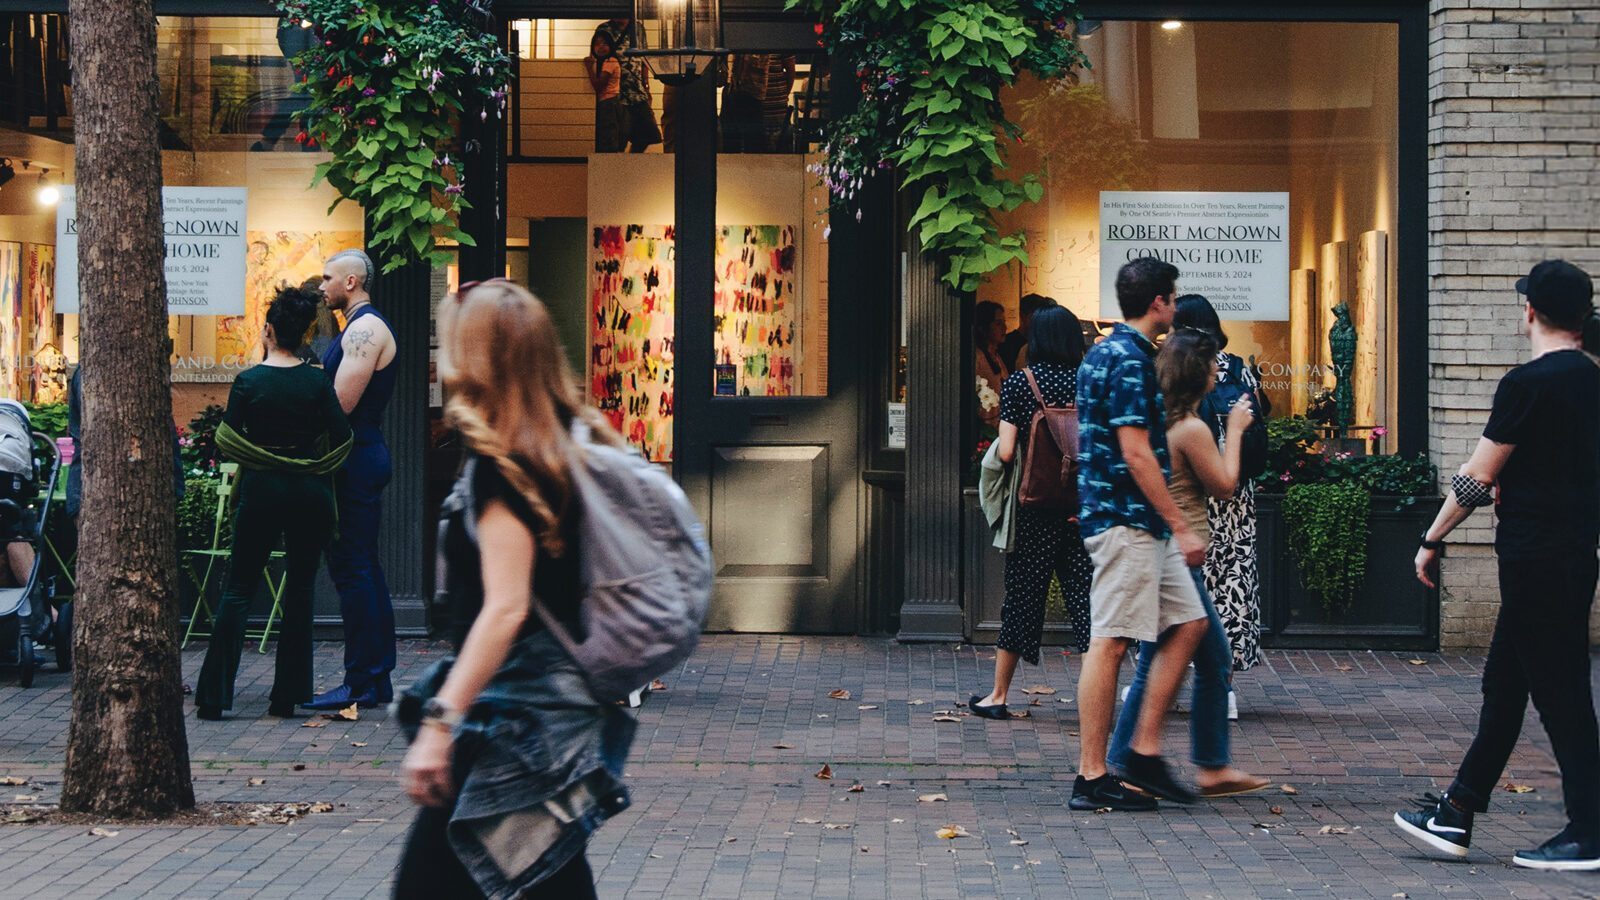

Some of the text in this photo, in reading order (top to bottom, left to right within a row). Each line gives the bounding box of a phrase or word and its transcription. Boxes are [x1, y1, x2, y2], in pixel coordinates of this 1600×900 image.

[1259, 203, 1285, 211] Paintings
[163, 220, 239, 234] CNOWN
[1108, 224, 1182, 240] ROBERT
[164, 243, 220, 258] HOME
[1126, 248, 1262, 264] COMING HOME
[190, 265, 209, 273] 2024
[1232, 271, 1253, 279] 2024
[167, 296, 209, 305] OHNSON
[1211, 302, 1252, 311] OHNSON
[176, 355, 217, 369] AND
[170, 374, 235, 383] ONTEMPOR
